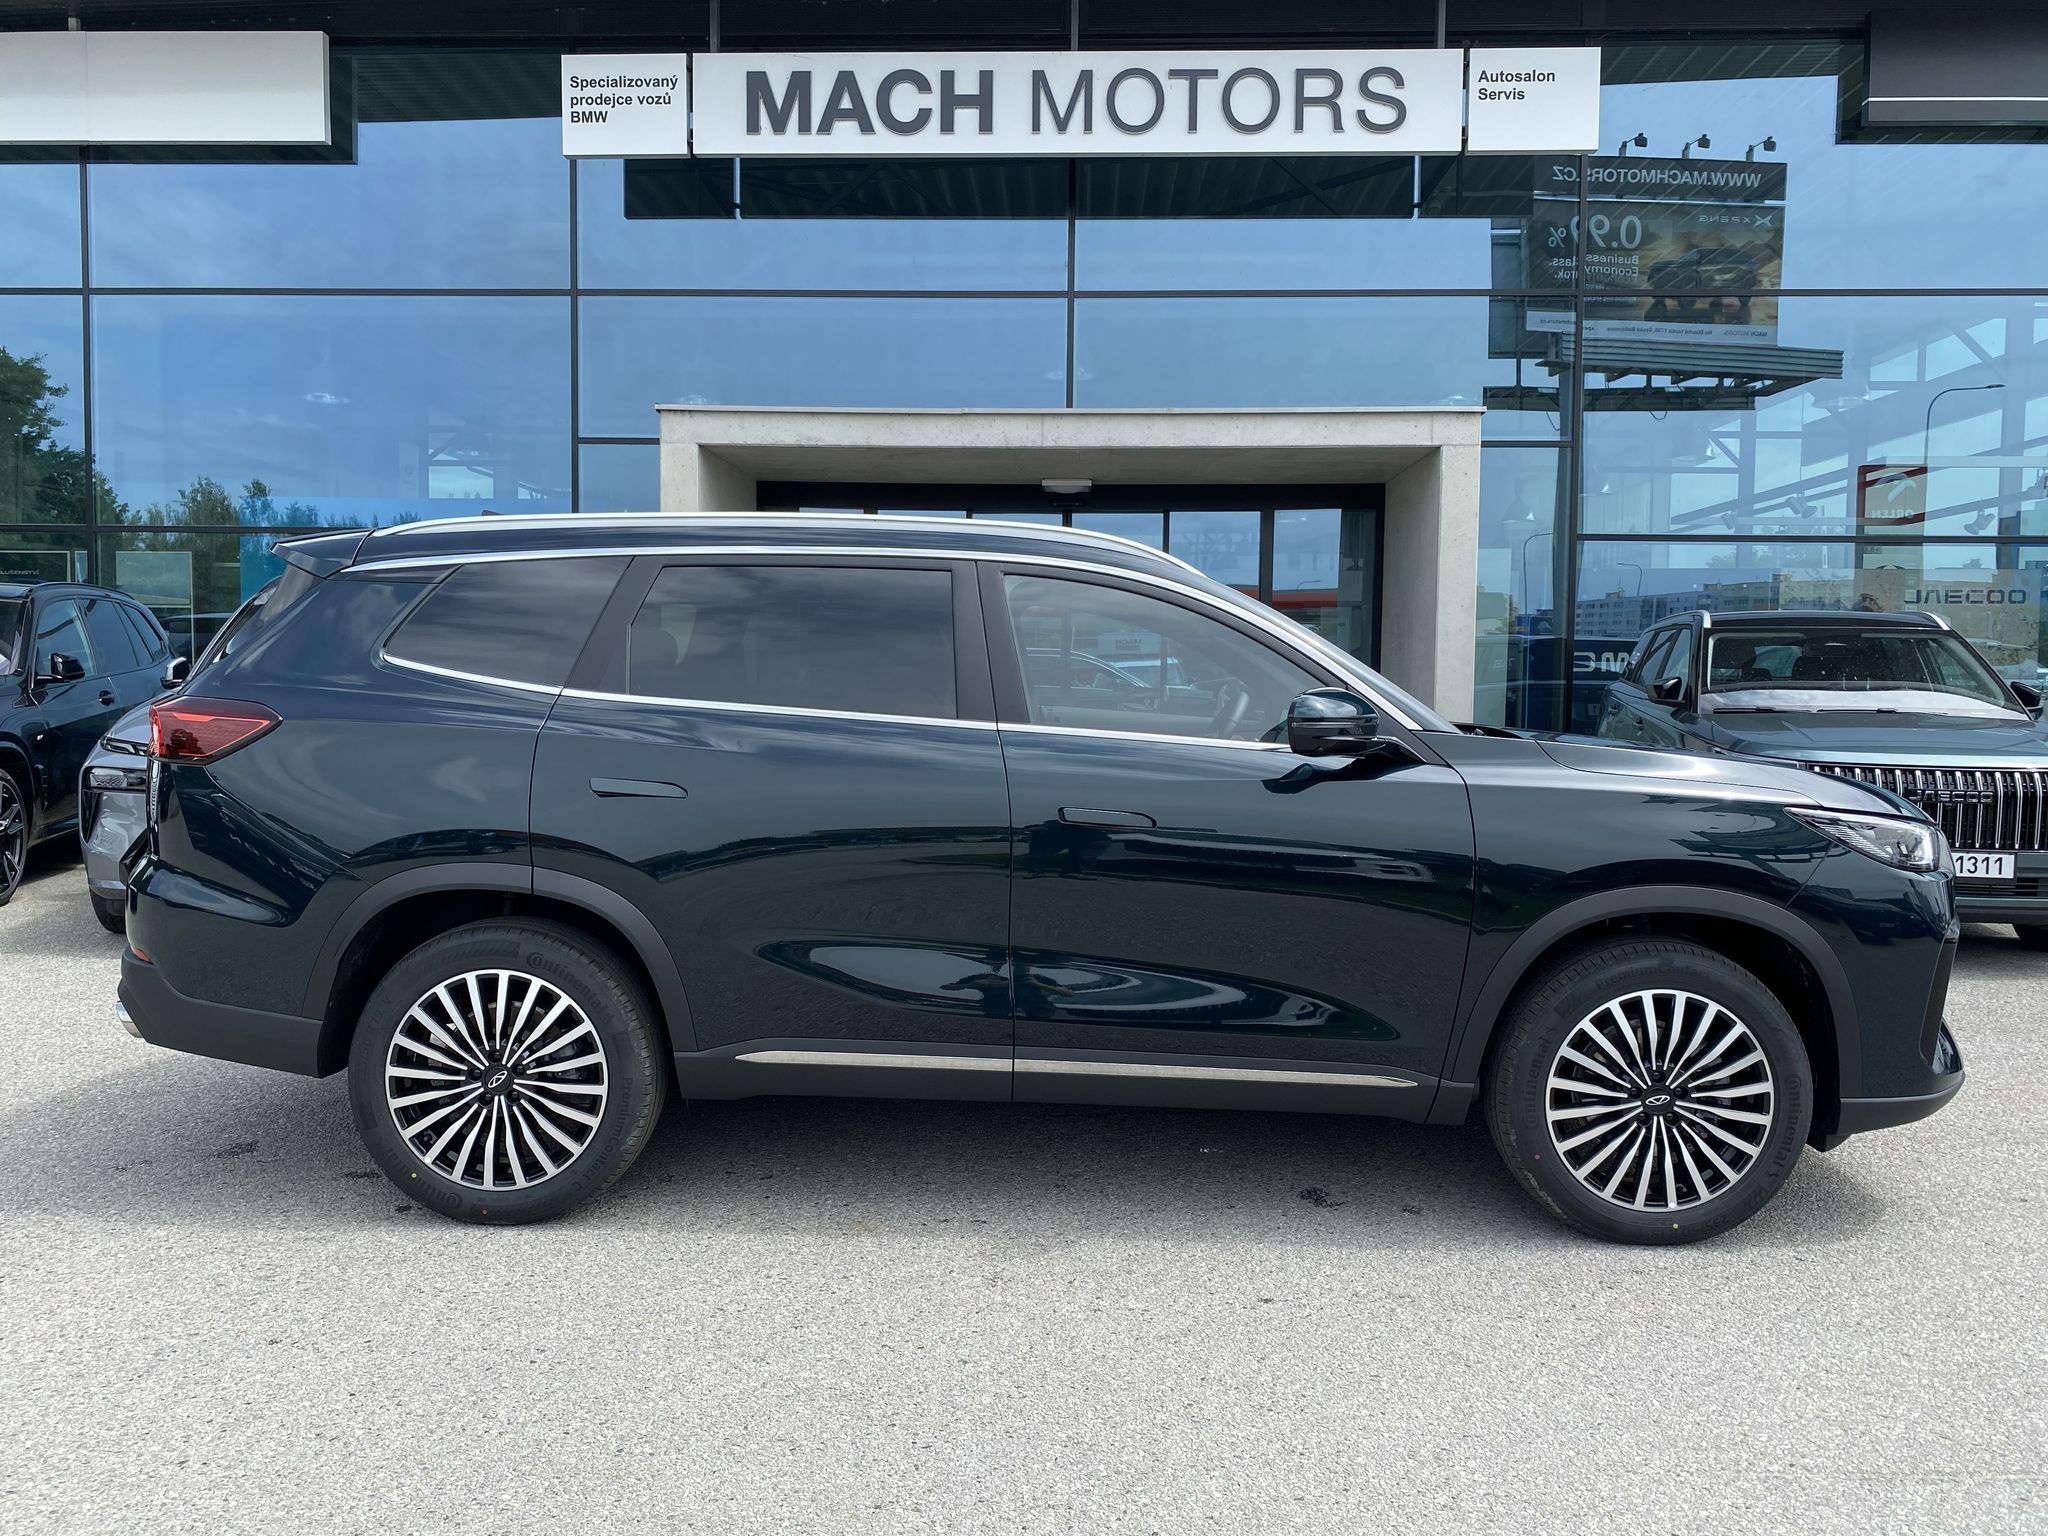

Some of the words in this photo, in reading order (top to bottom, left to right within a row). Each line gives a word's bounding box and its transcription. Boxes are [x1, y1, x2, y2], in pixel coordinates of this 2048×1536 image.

[569, 74, 679, 91] Specializovaný
[1477, 69, 1556, 84] Autosalon
[570, 93, 633, 109] prodejce
[637, 91, 672, 105] vozů
[746, 68, 994, 136] MACH
[1030, 66, 1408, 135] MOTORS
[1477, 86, 1526, 101] Servis
[570, 110, 609, 124] BMW
[1908, 790, 1994, 803] JAECOO
[1955, 855, 2004, 875] 1311
[524, 951, 609, 1017] Continental
